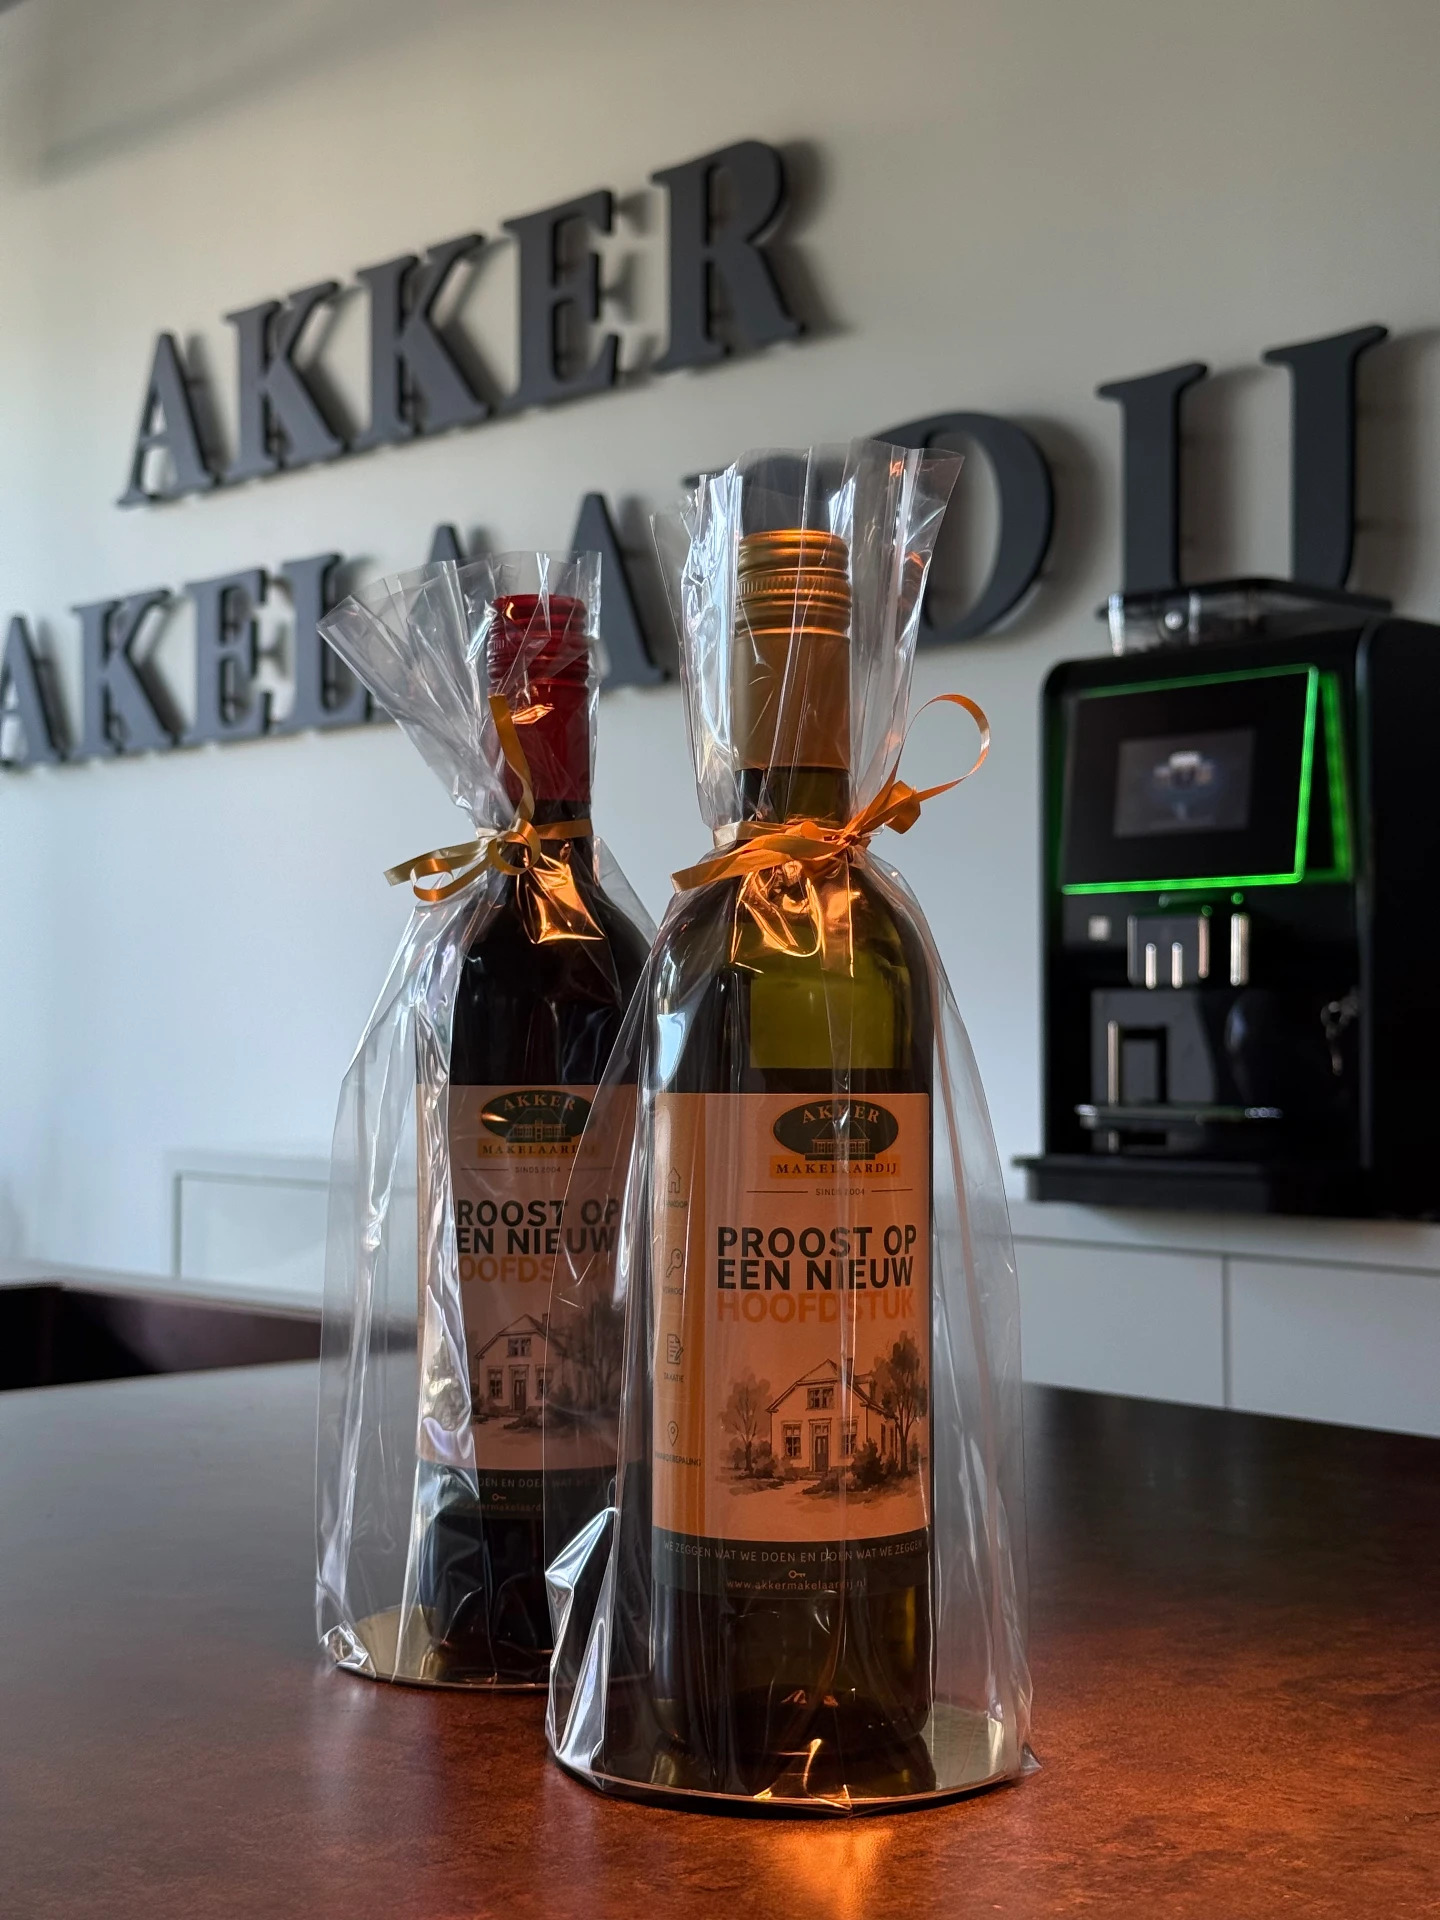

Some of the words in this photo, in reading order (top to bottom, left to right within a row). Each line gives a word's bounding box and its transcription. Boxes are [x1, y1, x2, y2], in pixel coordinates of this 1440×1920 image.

[117, 139, 807, 507] AKKER
[504, 1094, 576, 1111] AKKER
[775, 1162, 897, 1175] MAKELARDIJ
[815, 1188, 840, 1196] SIND
[455, 1199, 568, 1227] ROOST
[457, 1227, 494, 1254] EN
[507, 1227, 616, 1255] NIEUW
[717, 1226, 872, 1258] PROOST
[883, 1224, 917, 1255] OP
[717, 1258, 790, 1290] EEN
[806, 1256, 914, 1290] NIEUW
[716, 1287, 915, 1324] HOOFDSTUK
[664, 1541, 674, 1551] WE
[676, 1543, 711, 1558] ZEGGEN
[715, 1549, 736, 1560] WAT
[740, 1551, 757, 1561] WE
[761, 1552, 795, 1562] DOEN
[800, 1552, 816, 1563] EN
[856, 1548, 877, 1559] WAT
[880, 1545, 893, 1557] WE
[895, 1539, 923, 1555] ZEGGEN
[726, 1577, 867, 1591] www.akkermakelaarij.nl
